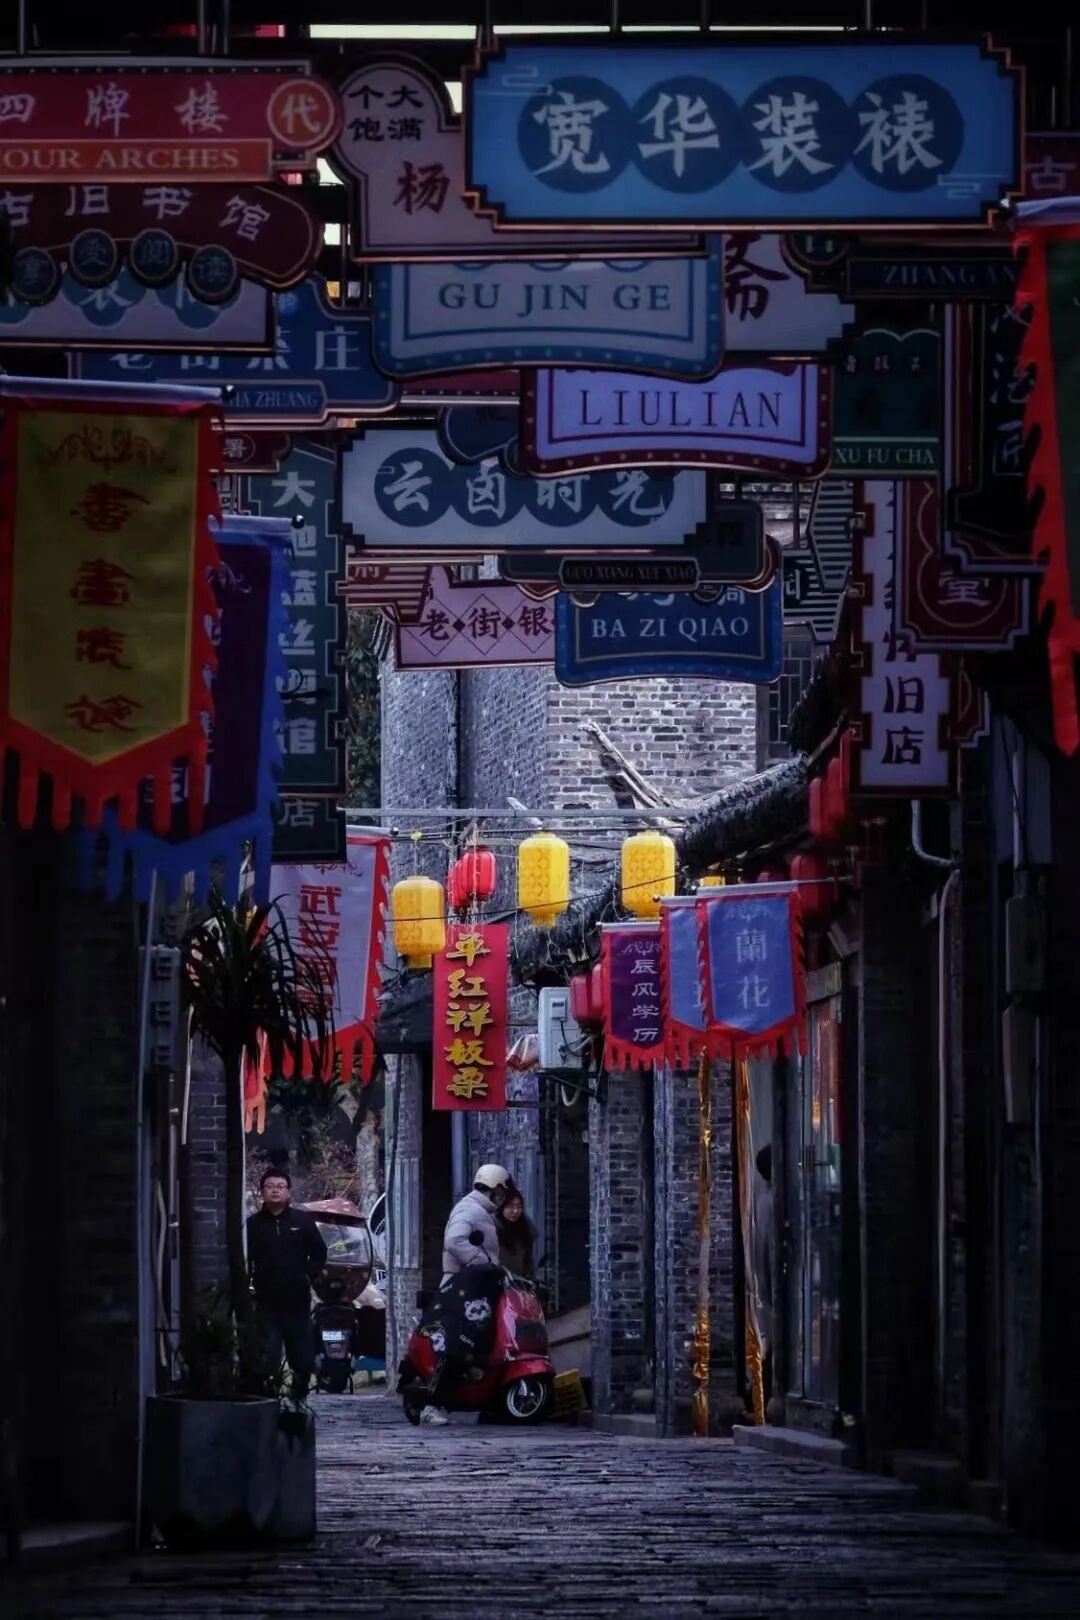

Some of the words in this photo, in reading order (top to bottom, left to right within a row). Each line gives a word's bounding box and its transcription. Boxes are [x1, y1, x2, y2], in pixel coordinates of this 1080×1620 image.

[0, 80, 228, 137] 四牌楼
[348, 86, 424, 109] 个大
[281, 93, 321, 134] 代
[348, 117, 424, 141] 饱满
[532, 91, 944, 178] 宽华装裱
[3, 149, 80, 168] OUR
[95, 149, 240, 168] ARCHES
[393, 160, 450, 215] 杨
[438, 283, 500, 310] GU
[517, 284, 590, 317] JIN
[613, 284, 671, 311] GE
[254, 391, 318, 408] ZHUANG
[578, 388, 783, 428] LIULIAN
[835, 447, 861, 464] XU
[867, 447, 891, 464] FU
[895, 447, 936, 464] CHA
[591, 618, 626, 638] BA
[639, 618, 666, 638] ZI
[678, 618, 749, 643] QIAO
